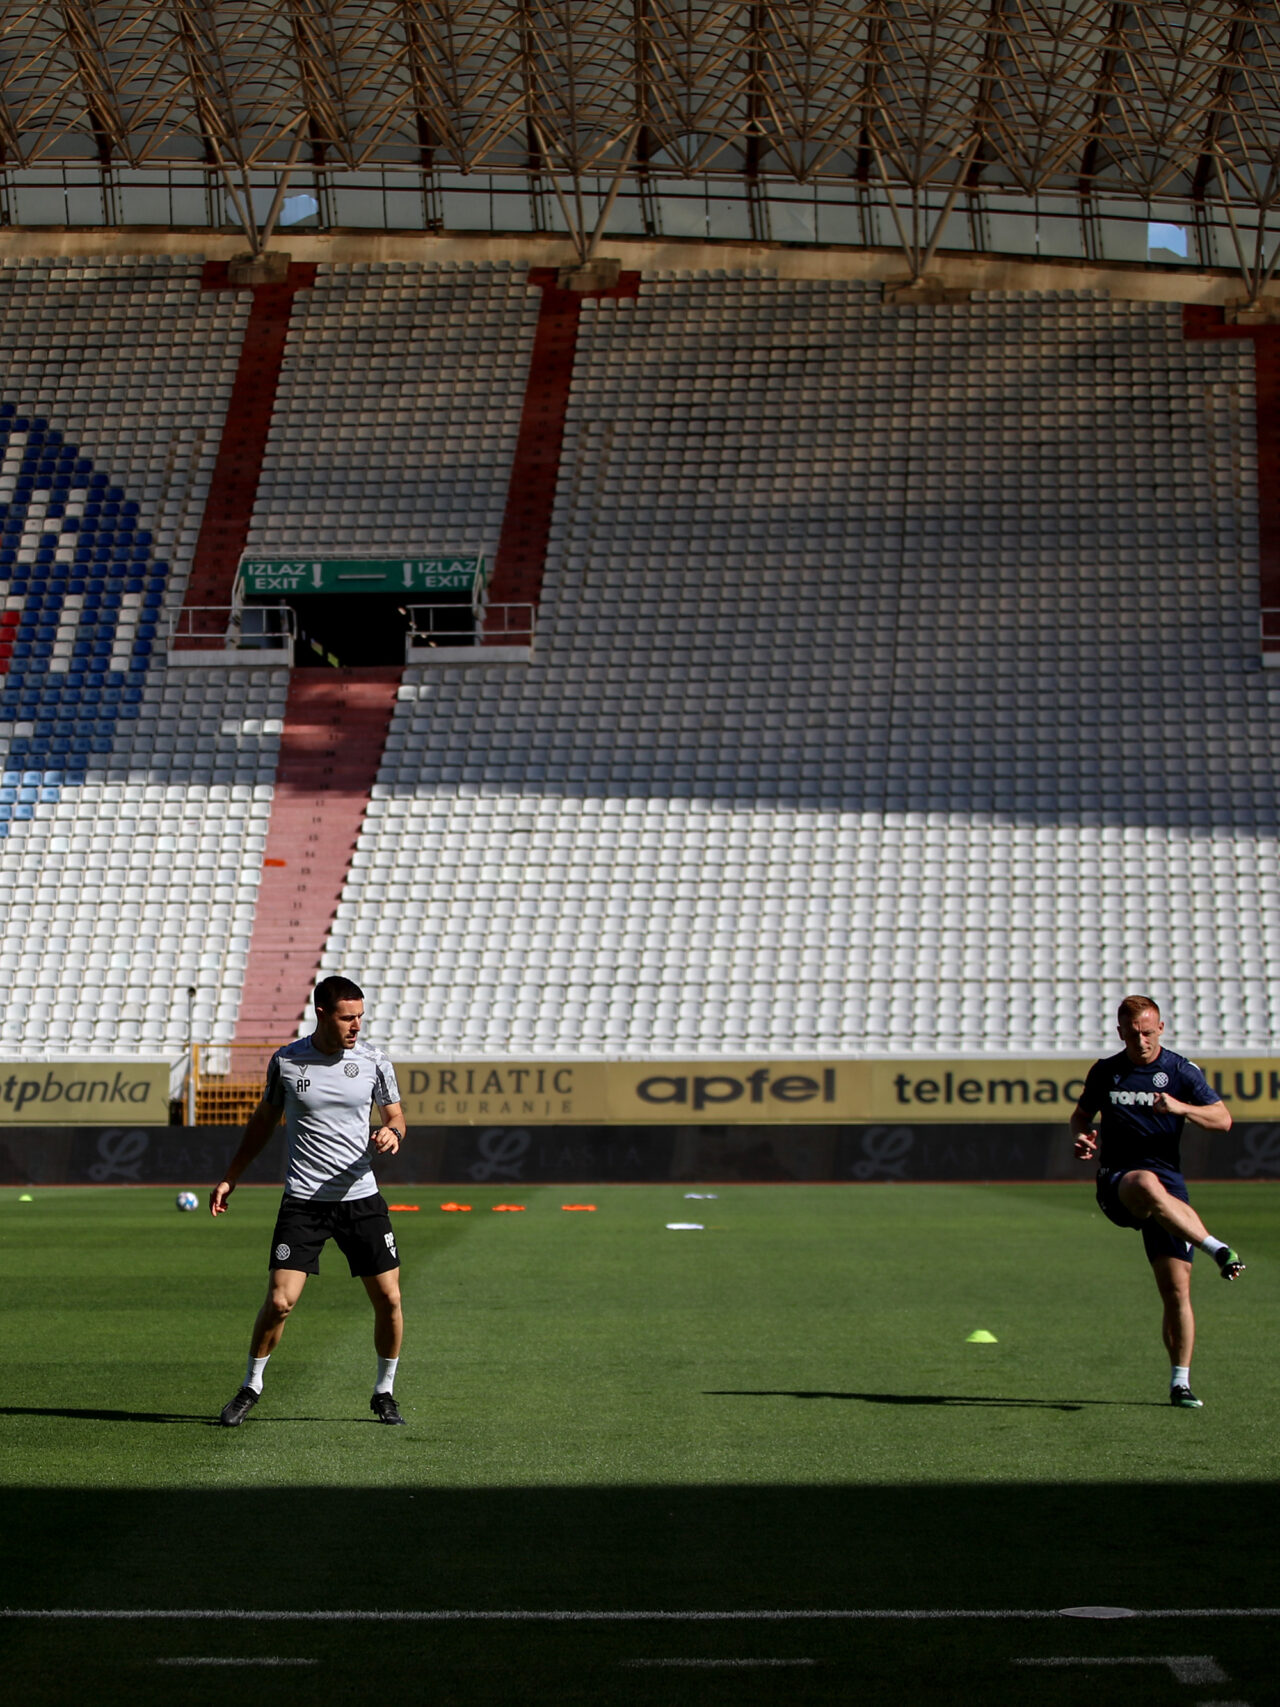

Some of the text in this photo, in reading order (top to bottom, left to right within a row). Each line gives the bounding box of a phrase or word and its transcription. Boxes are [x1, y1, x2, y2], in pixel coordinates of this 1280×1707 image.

[247, 563, 307, 576] IZLAZ
[418, 561, 477, 574] IZLAZ
[254, 577, 301, 590] EXIT
[425, 574, 471, 588] EXIT
[296, 1079, 311, 1093] AP
[408, 1068, 575, 1096] DRIATIC
[636, 1067, 837, 1111] apfel
[893, 1071, 1087, 1105] telemac
[1108, 1090, 1155, 1107] TOMM
